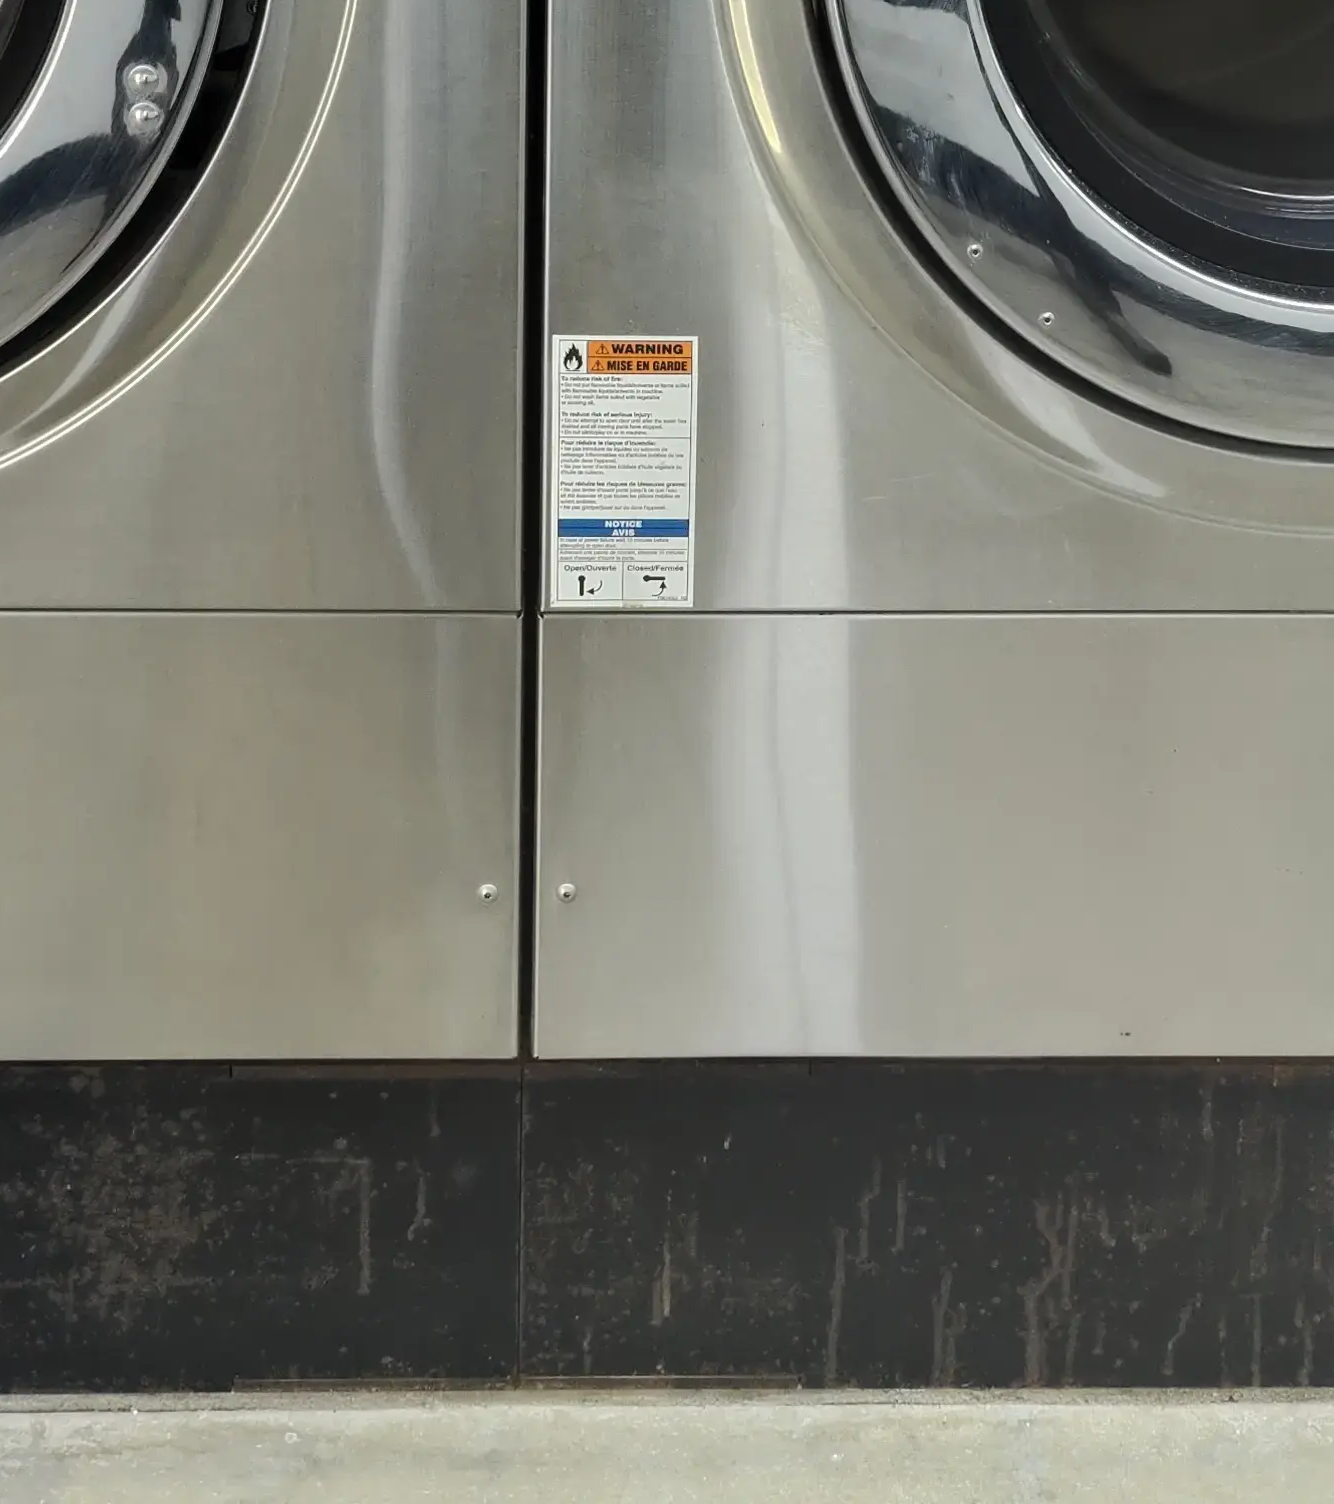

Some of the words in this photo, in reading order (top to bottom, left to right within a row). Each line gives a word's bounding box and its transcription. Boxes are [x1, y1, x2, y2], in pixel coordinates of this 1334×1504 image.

[612, 344, 683, 354] WARNING
[607, 360, 632, 371] MISE
[637, 360, 649, 371] EN
[653, 360, 687, 371] GARDE
